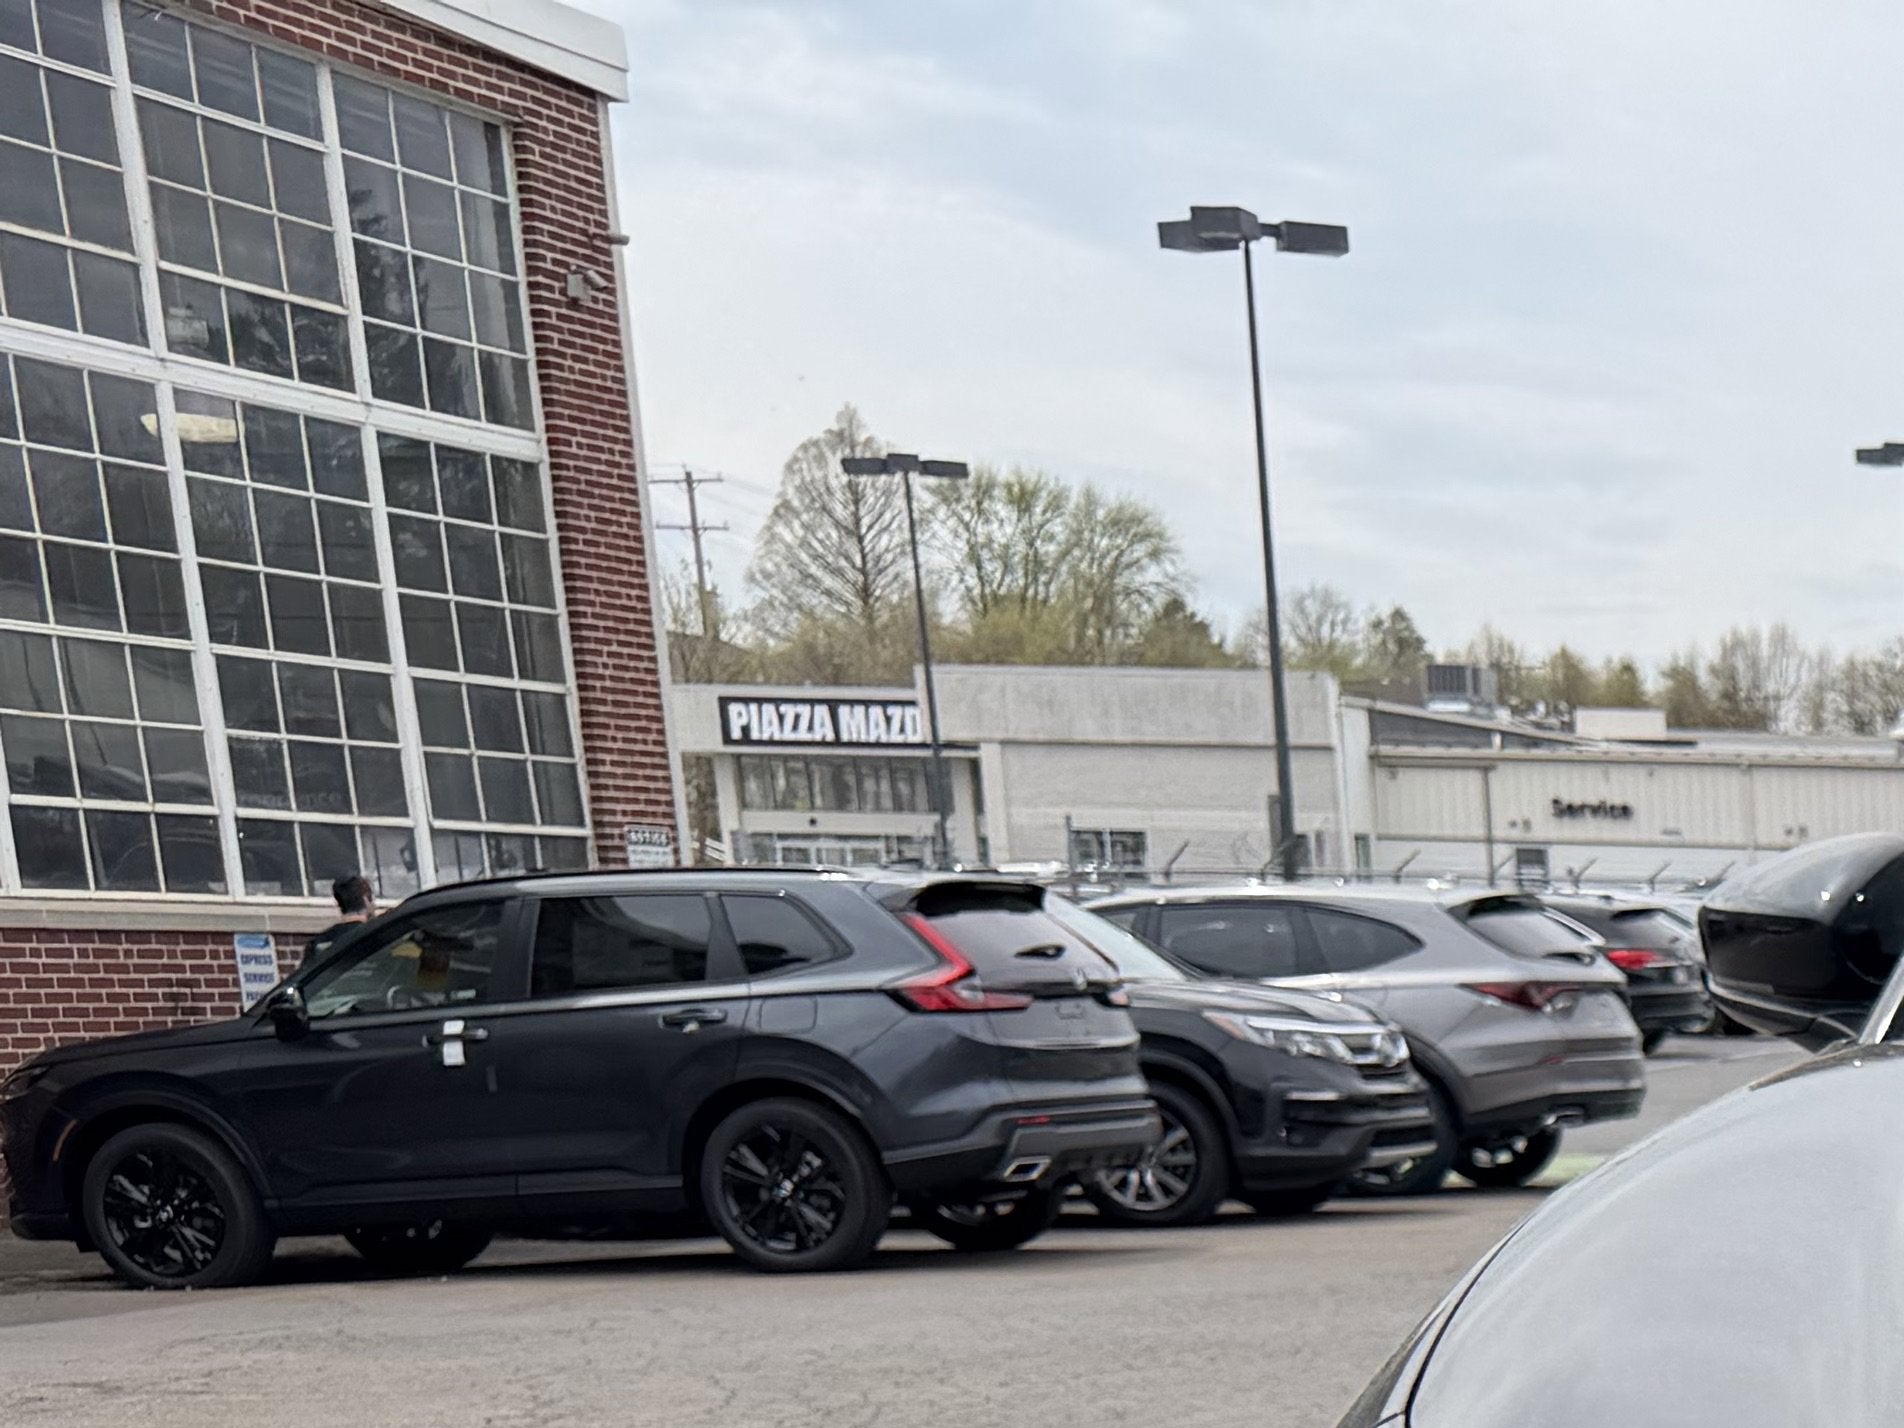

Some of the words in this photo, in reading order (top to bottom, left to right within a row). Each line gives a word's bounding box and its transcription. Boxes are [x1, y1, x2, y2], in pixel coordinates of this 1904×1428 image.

[728, 702, 836, 743] PIAZZA
[838, 704, 924, 743] MAZD
[1552, 798, 1634, 819] Service
